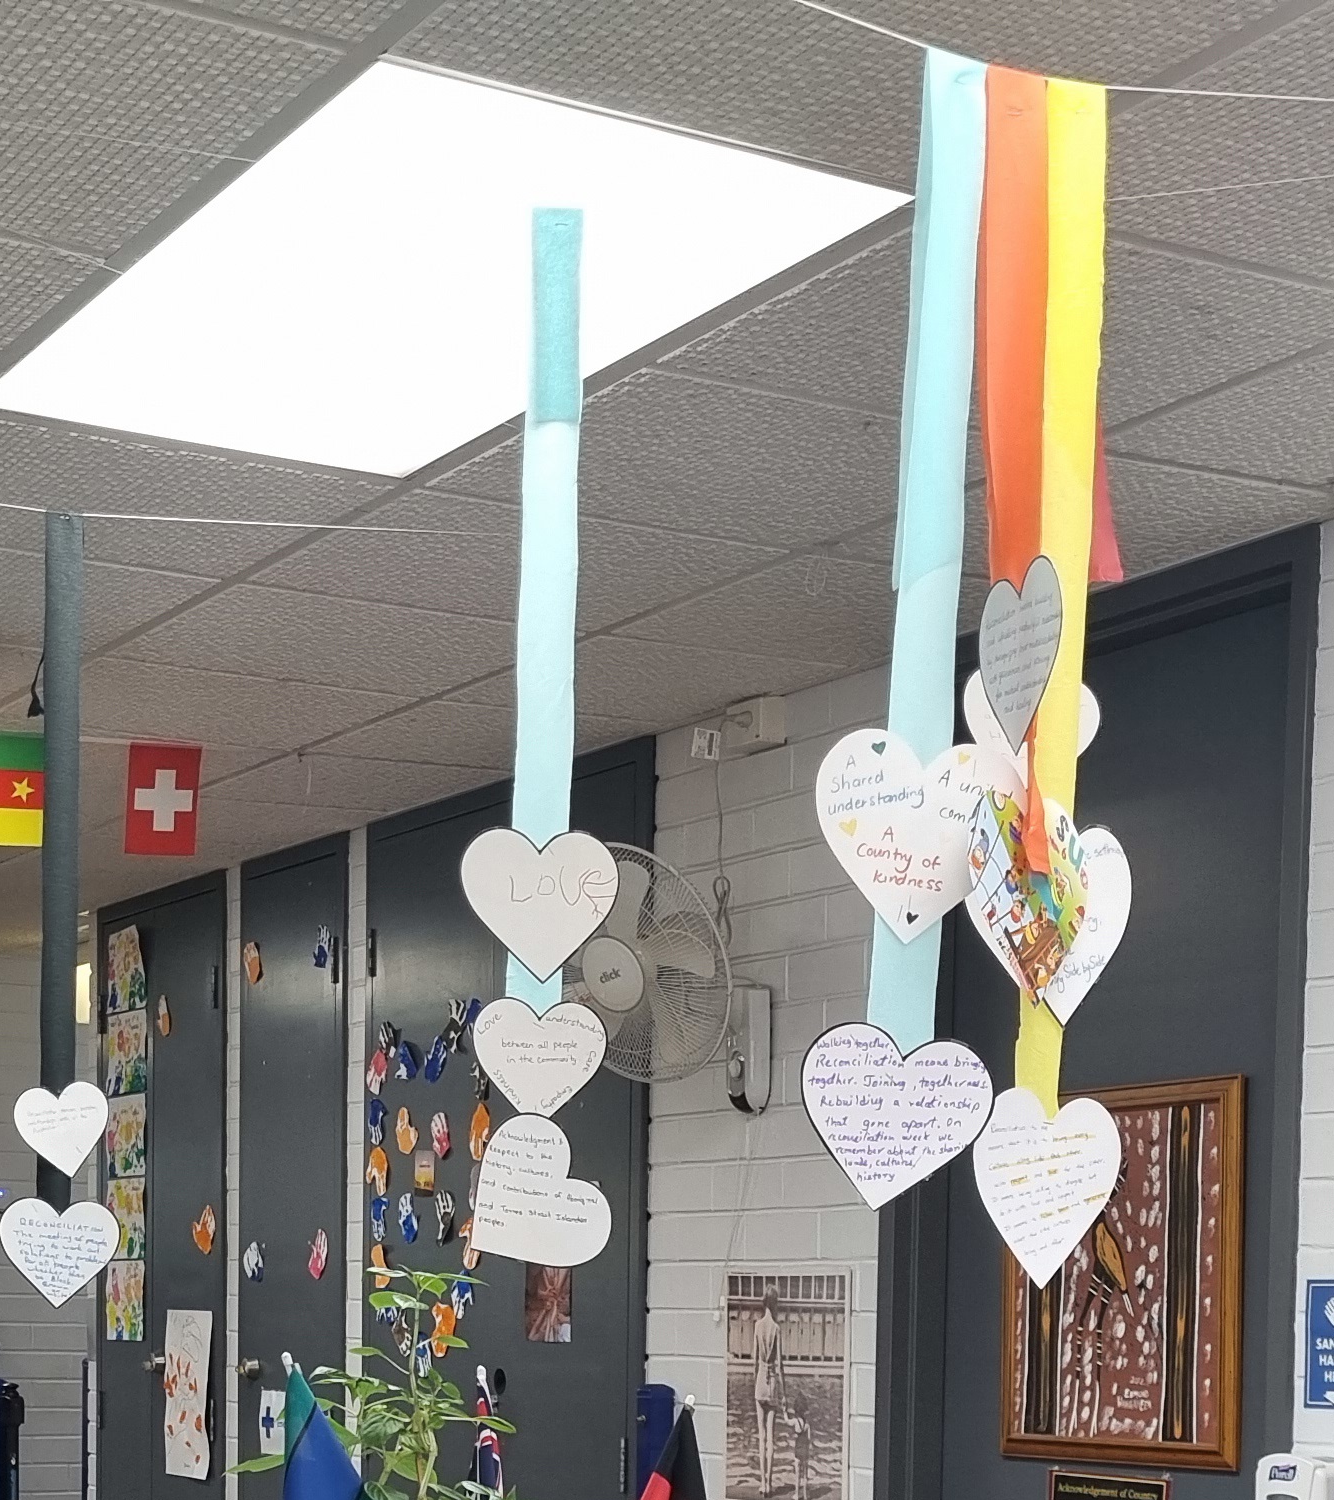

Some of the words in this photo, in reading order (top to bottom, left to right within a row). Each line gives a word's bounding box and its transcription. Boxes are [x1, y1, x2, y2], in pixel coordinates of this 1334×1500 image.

[846, 755, 856, 770] A
[830, 770, 884, 793] Shared
[828, 785, 925, 816] understanding
[881, 826, 894, 843] A
[856, 843, 912, 873] Country
[922, 857, 941, 871] of
[600, 968, 621, 984] click
[1058, 1482, 1118, 1497] Acknowledgement
[1120, 1489, 1126, 1498] of
